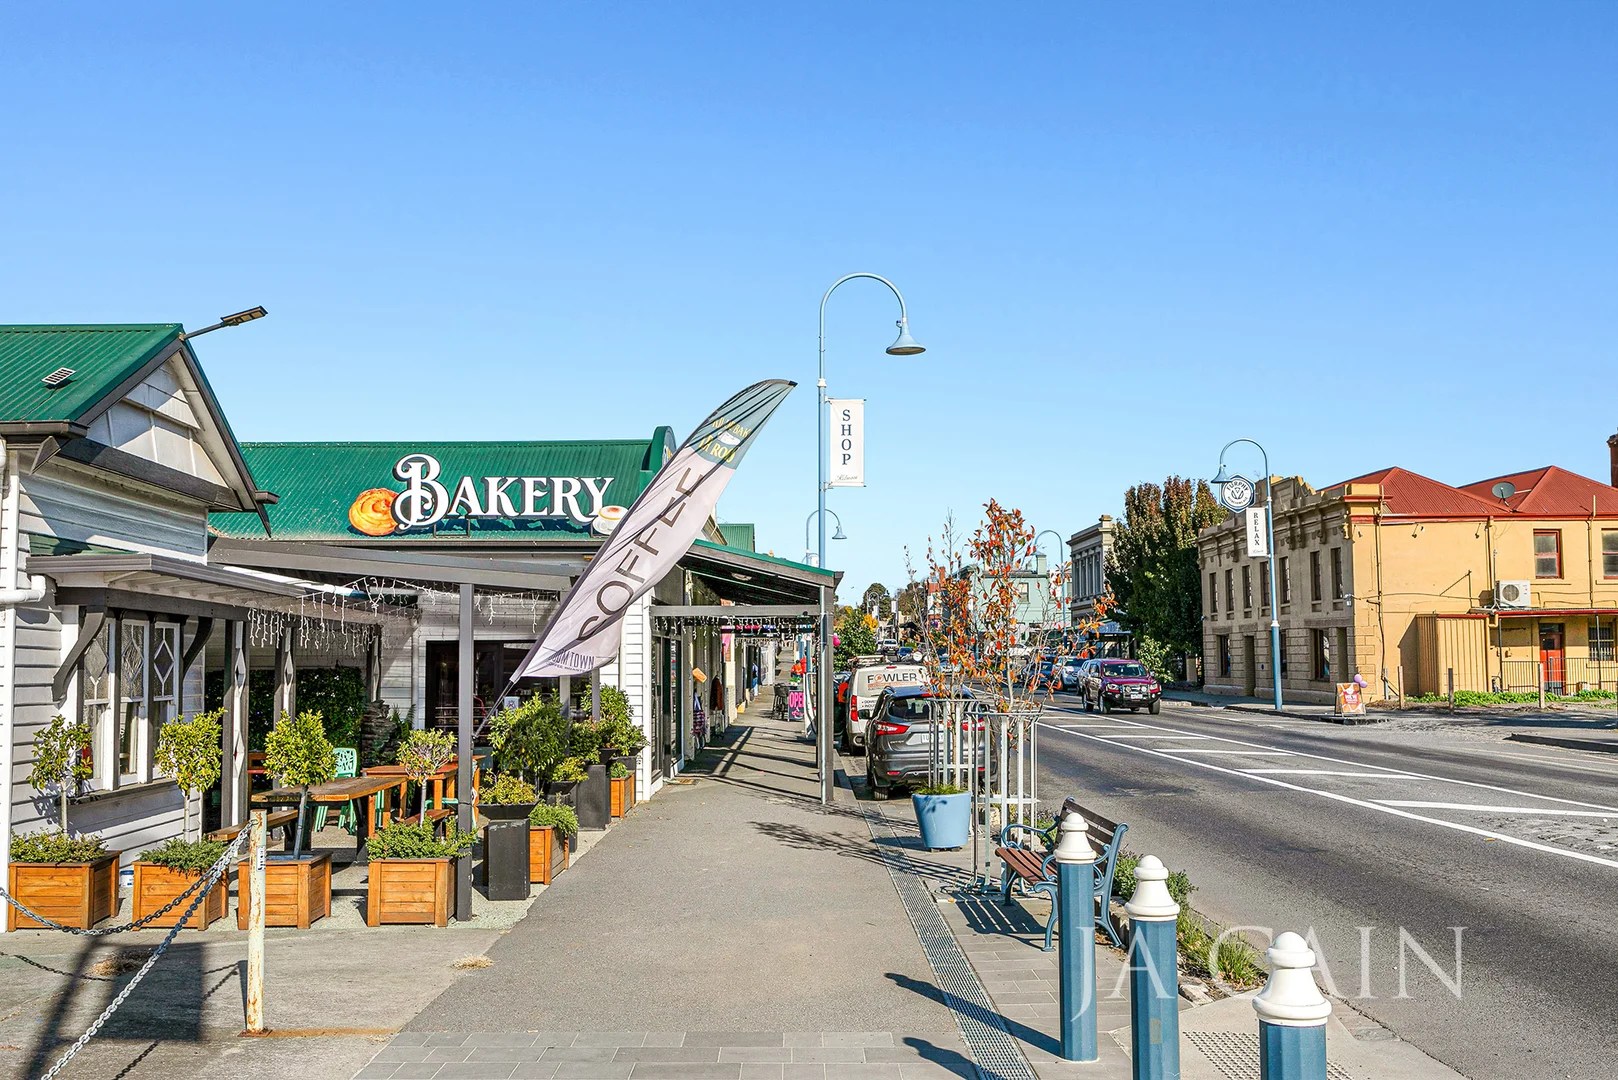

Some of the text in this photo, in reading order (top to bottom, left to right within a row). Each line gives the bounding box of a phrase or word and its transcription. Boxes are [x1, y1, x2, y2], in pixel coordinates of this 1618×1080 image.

[841, 409, 852, 466] SHOP
[391, 453, 614, 531] BAKERY
[577, 466, 704, 642] COFFEE
[569, 651, 595, 670] TOWN
